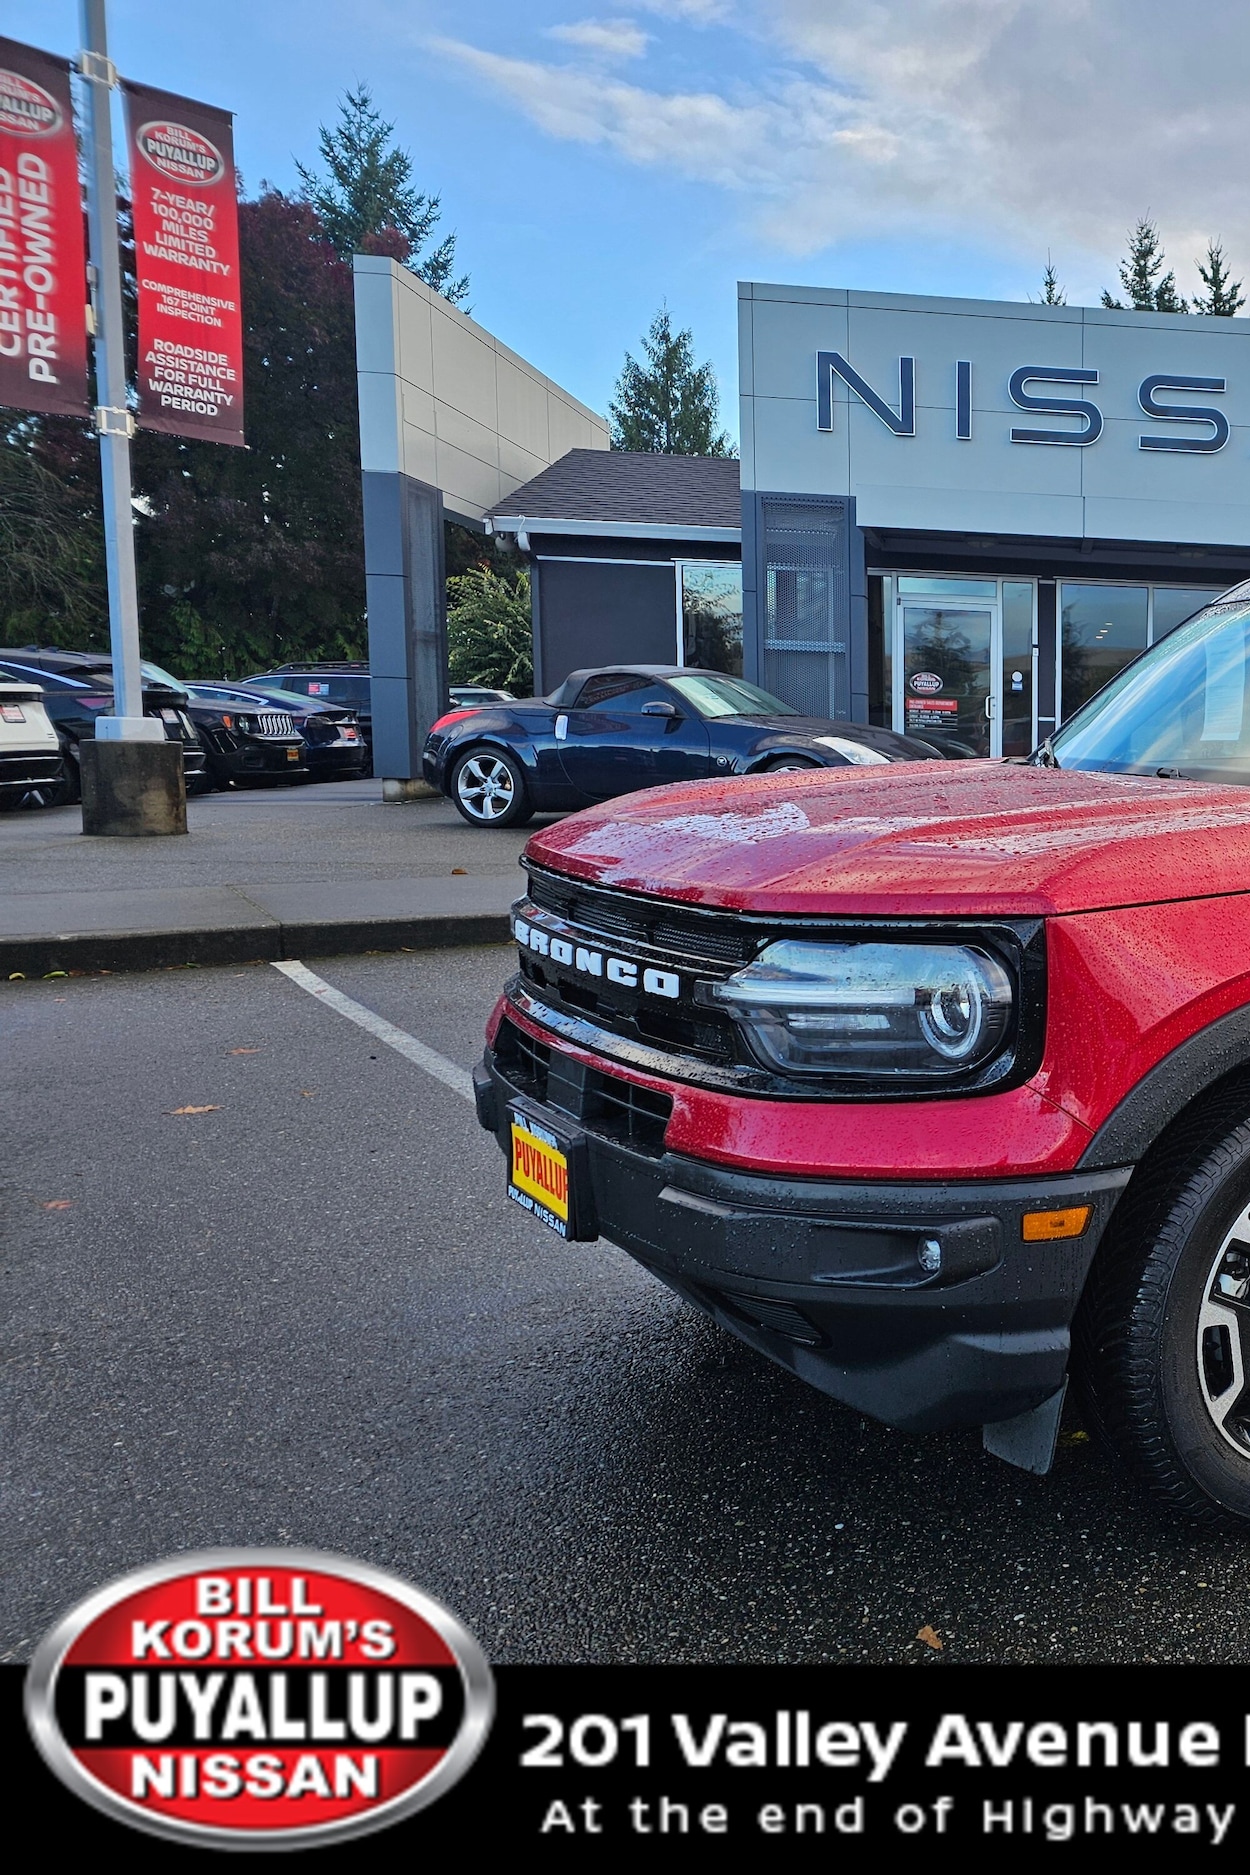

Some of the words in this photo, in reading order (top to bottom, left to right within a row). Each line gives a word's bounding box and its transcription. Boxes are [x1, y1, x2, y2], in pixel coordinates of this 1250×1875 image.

[0, 94, 54, 122] ALLUP
[0, 111, 40, 131] SSAN
[154, 131, 207, 153] KORUM'S
[166, 126, 192, 142] BILL
[146, 138, 216, 172] PUYALLUP
[156, 157, 205, 179] NISSAN
[150, 186, 215, 217] 7-YEAR/
[150, 201, 214, 231] 100,000
[155, 230, 216, 259] LIMITED
[162, 219, 209, 243] MILES
[17, 152, 57, 384] PRE-OWNED
[142, 241, 230, 276] WARRANTY
[141, 279, 236, 311] COMPREHENSIVE
[161, 294, 180, 306] 167
[181, 299, 216, 316] POINT
[156, 303, 222, 327] INSPECTION
[144, 350, 236, 381] ASSISTANCE
[153, 338, 228, 367] ROADSIDE
[148, 378, 234, 406] WARRANTY
[154, 365, 186, 384] FOR
[188, 373, 225, 392] FULL
[160, 394, 218, 417] PERIOD
[514, 918, 680, 999] BRONCO
[514, 1135, 569, 1205] PUYALLUP
[533, 1202, 567, 1238] NISSAN
